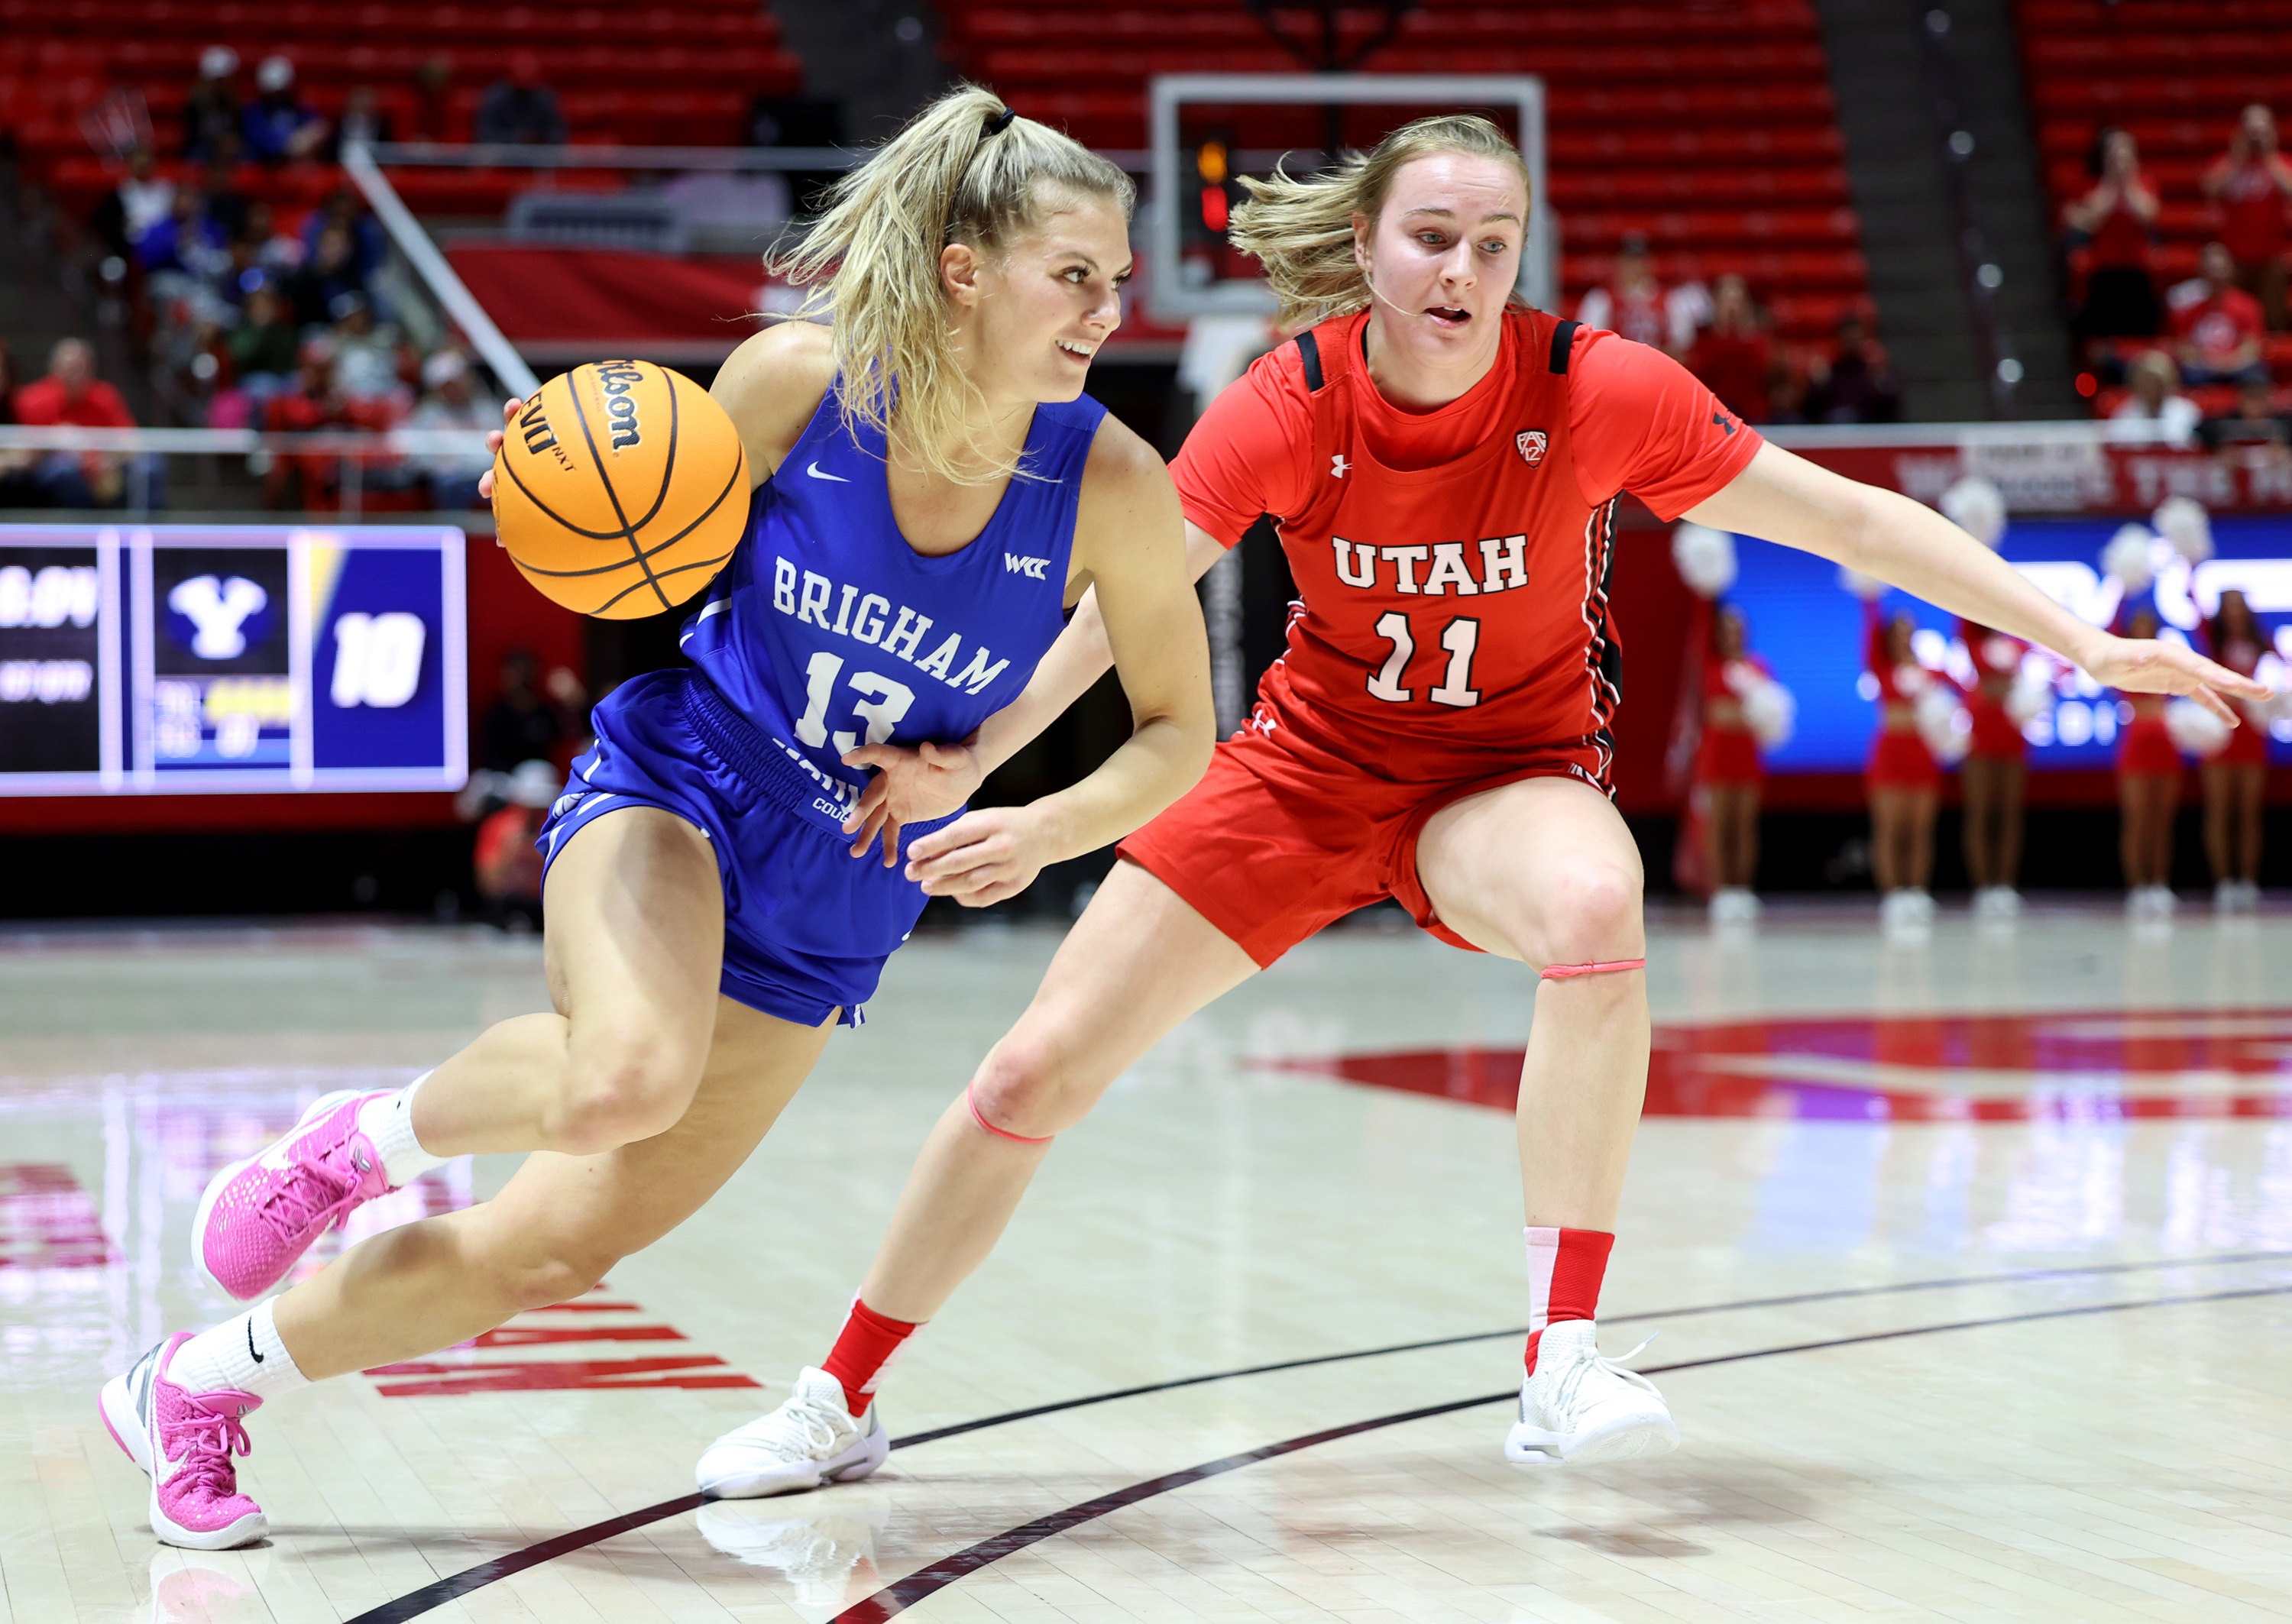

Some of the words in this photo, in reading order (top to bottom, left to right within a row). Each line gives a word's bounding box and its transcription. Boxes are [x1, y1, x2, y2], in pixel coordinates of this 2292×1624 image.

[520, 391, 558, 455] EVO
[552, 446, 578, 471] NXT
[1517, 431, 1547, 455] PAC
[1525, 447, 1542, 461] 12
[1004, 552, 1052, 581] WCC
[1332, 533, 1528, 596] UTAH
[330, 612, 426, 709] 10
[773, 555, 1011, 696] BRIGHAM
[1366, 610, 1481, 707] 11
[793, 652, 916, 770] 13
[812, 797, 850, 823] COUG
